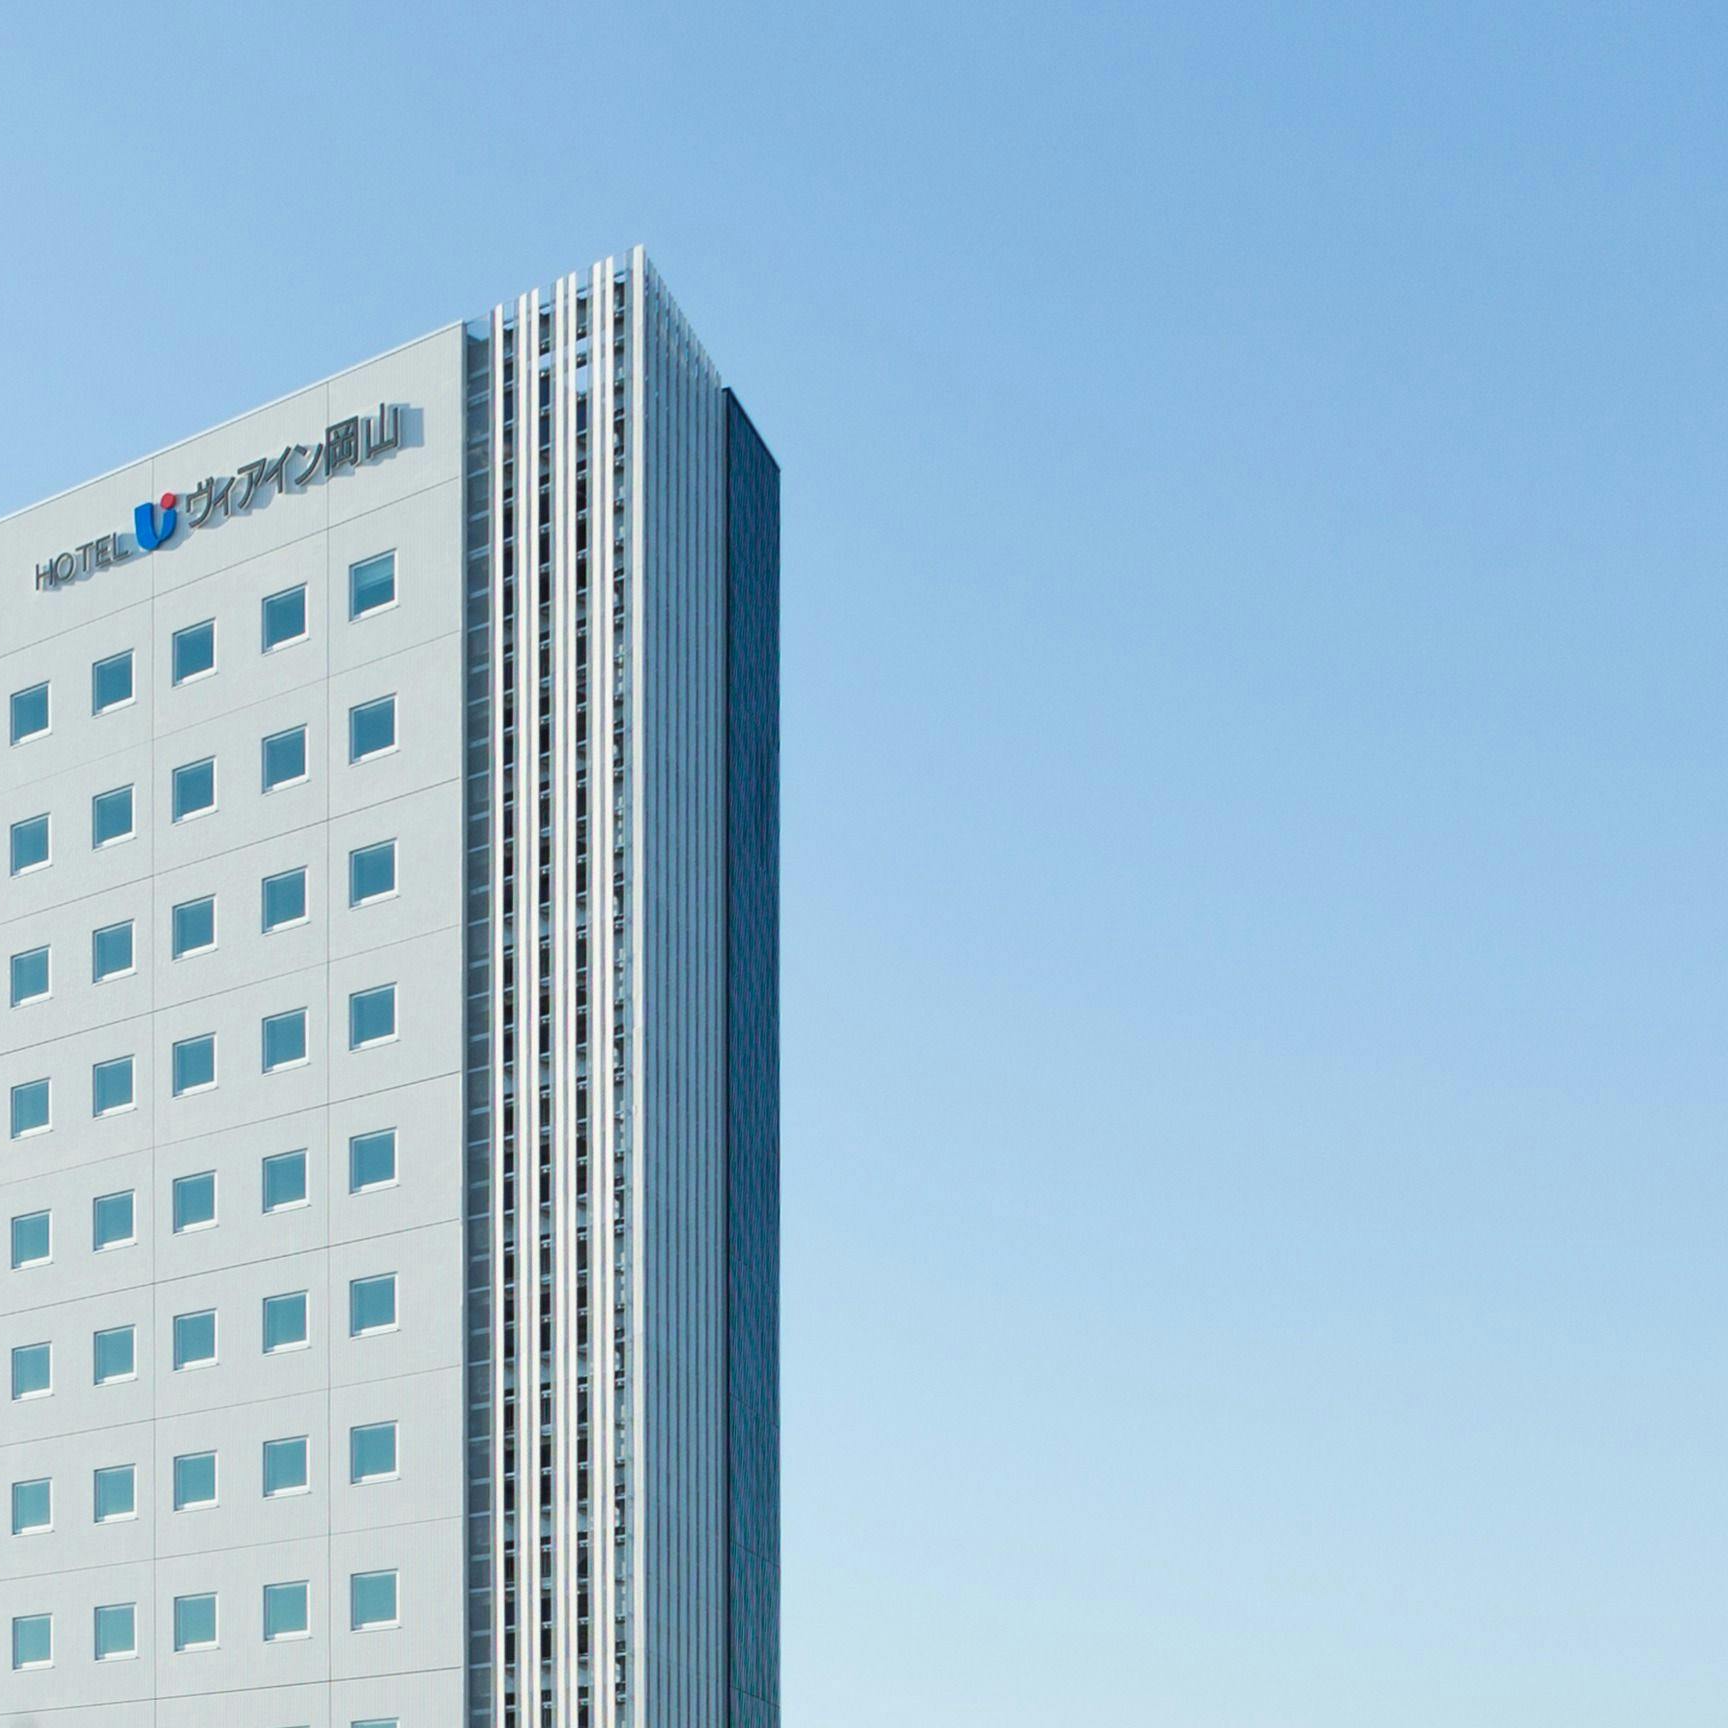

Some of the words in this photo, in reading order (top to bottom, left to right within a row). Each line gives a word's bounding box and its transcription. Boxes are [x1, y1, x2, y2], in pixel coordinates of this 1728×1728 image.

[184, 402, 401, 528] ヴィアイン岡山
[34, 531, 132, 591] HOTEL
